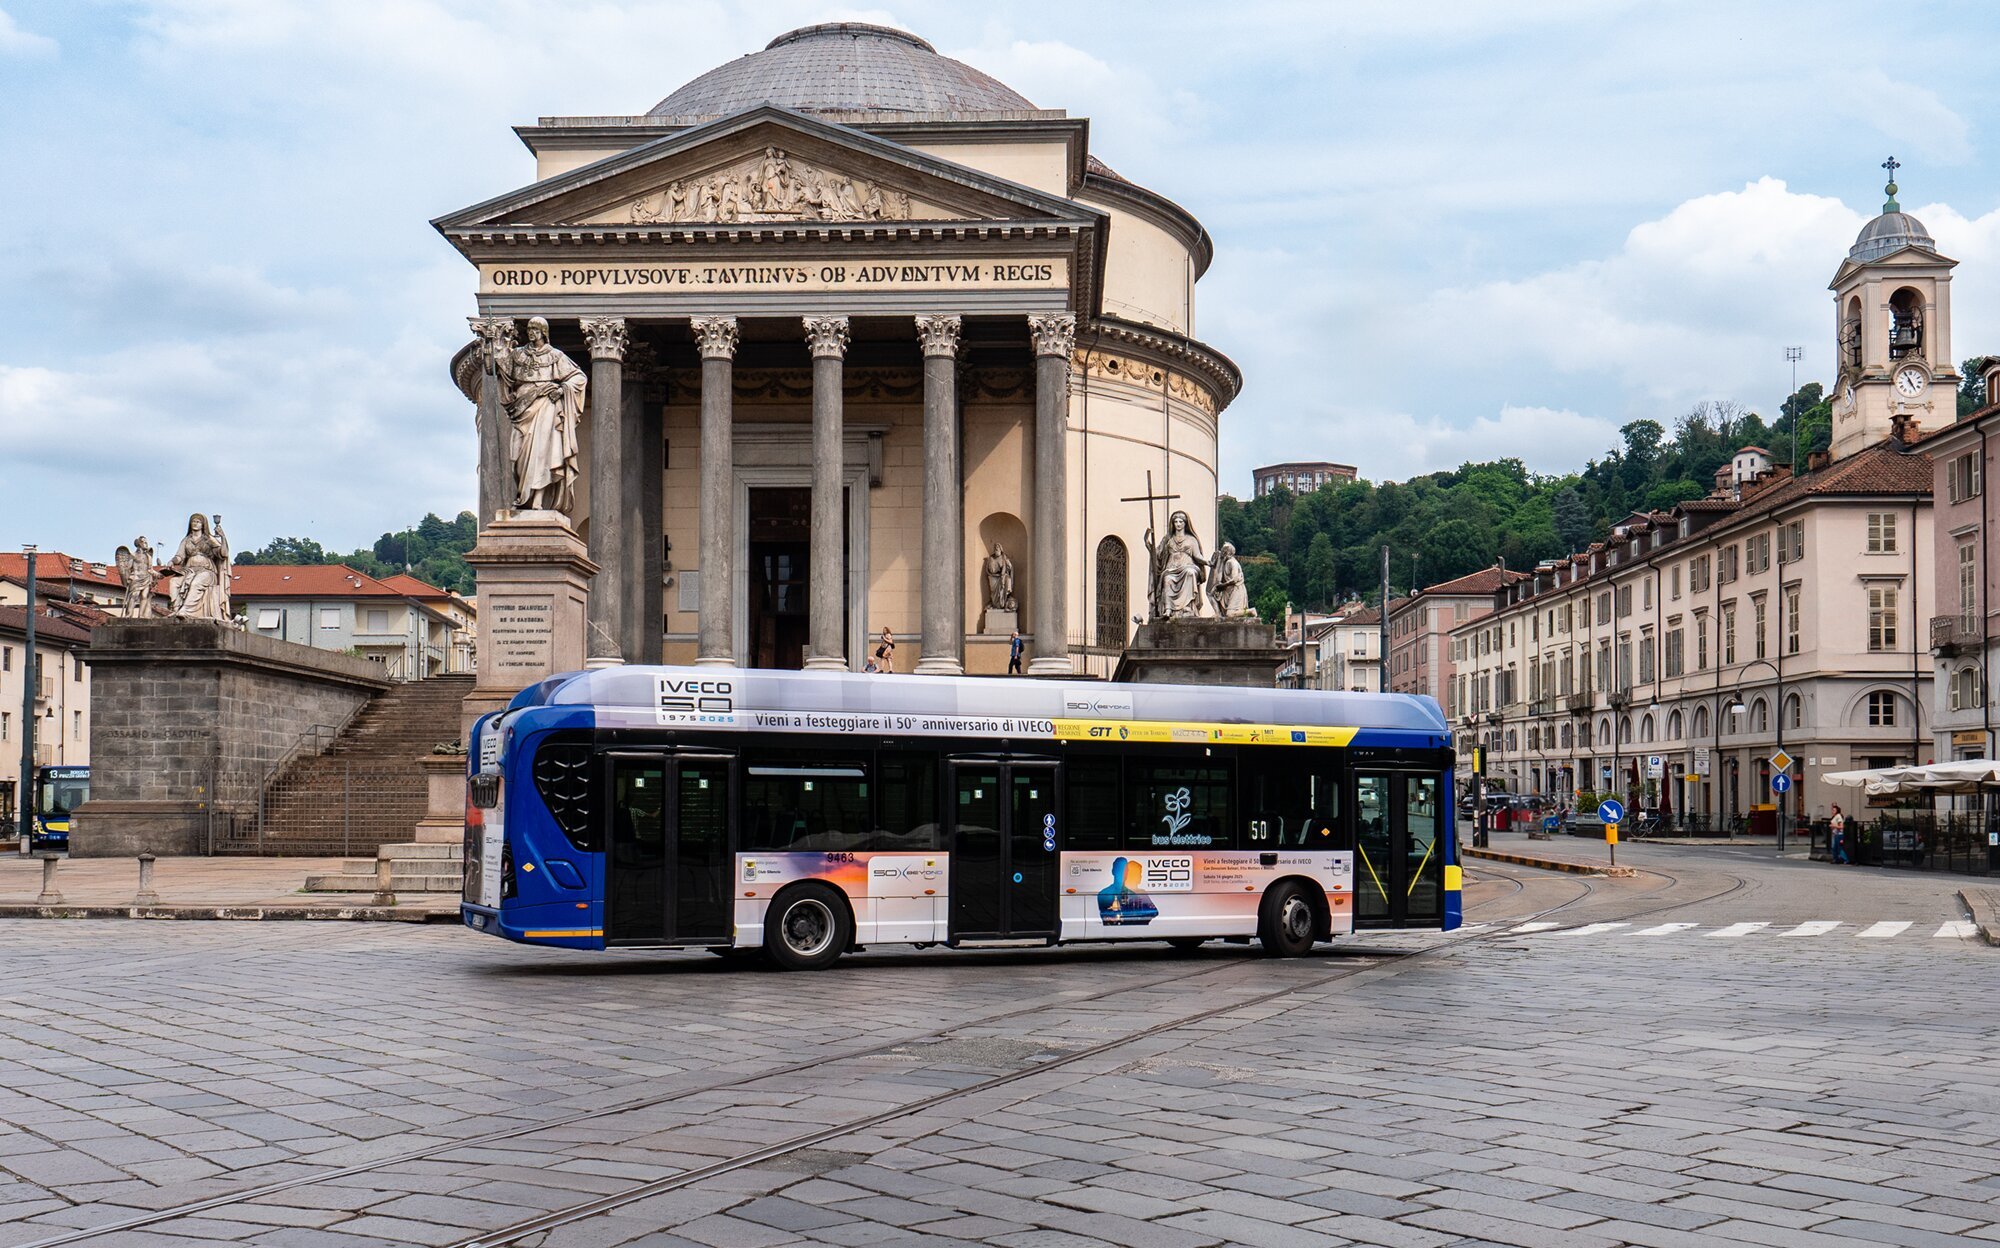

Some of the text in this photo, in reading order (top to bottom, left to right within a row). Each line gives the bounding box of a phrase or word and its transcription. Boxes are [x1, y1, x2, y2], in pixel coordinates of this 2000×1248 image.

[493, 270, 548, 285] ORDO
[820, 267, 846, 283] OB
[856, 265, 980, 283] ADVENTVM
[993, 264, 1052, 281] REGIS
[660, 680, 732, 694] IVECO
[661, 696, 732, 713] 50
[699, 715, 734, 723] 2025
[755, 712, 1053, 733] Vieni a festeggiare il 50° anniversario di IVECO
[1089, 726, 1112, 737] GTT
[49, 769, 58, 779] 13
[1251, 820, 1267, 840] 50
[1152, 834, 1212, 845] bus elettrico
[827, 853, 854, 863] 9463
[1148, 859, 1190, 868] IVECO
[873, 869, 898, 877] 50
[1148, 870, 1190, 881] 50
